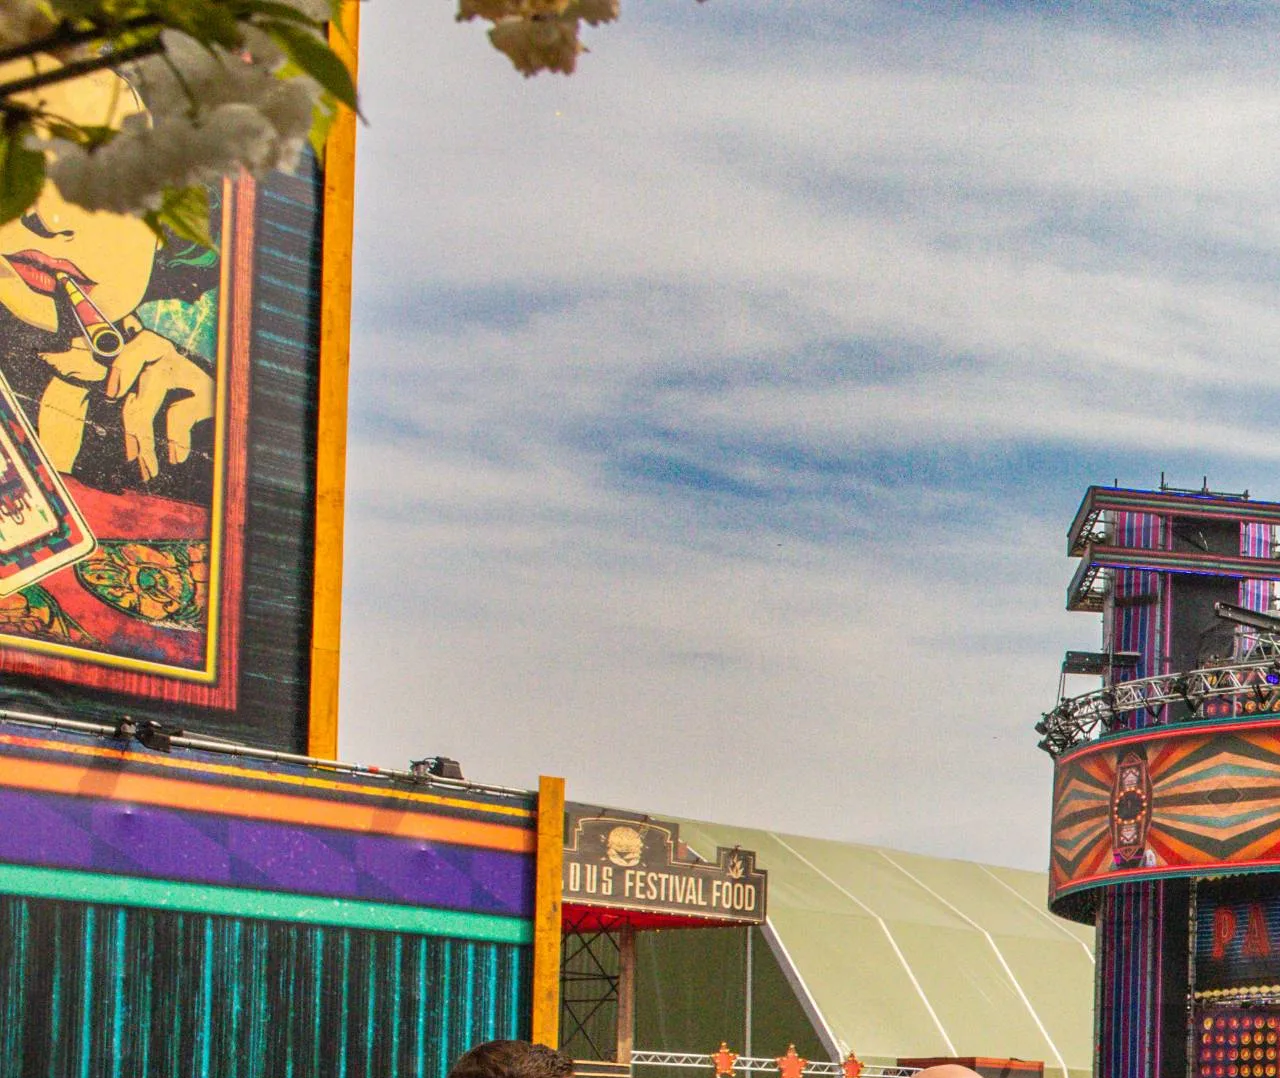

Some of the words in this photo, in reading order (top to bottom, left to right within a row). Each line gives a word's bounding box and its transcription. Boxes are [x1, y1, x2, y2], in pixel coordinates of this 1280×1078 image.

[563, 862, 613, 896] OUS
[624, 870, 707, 906] FESTIVAL
[712, 881, 756, 912] FOOD
